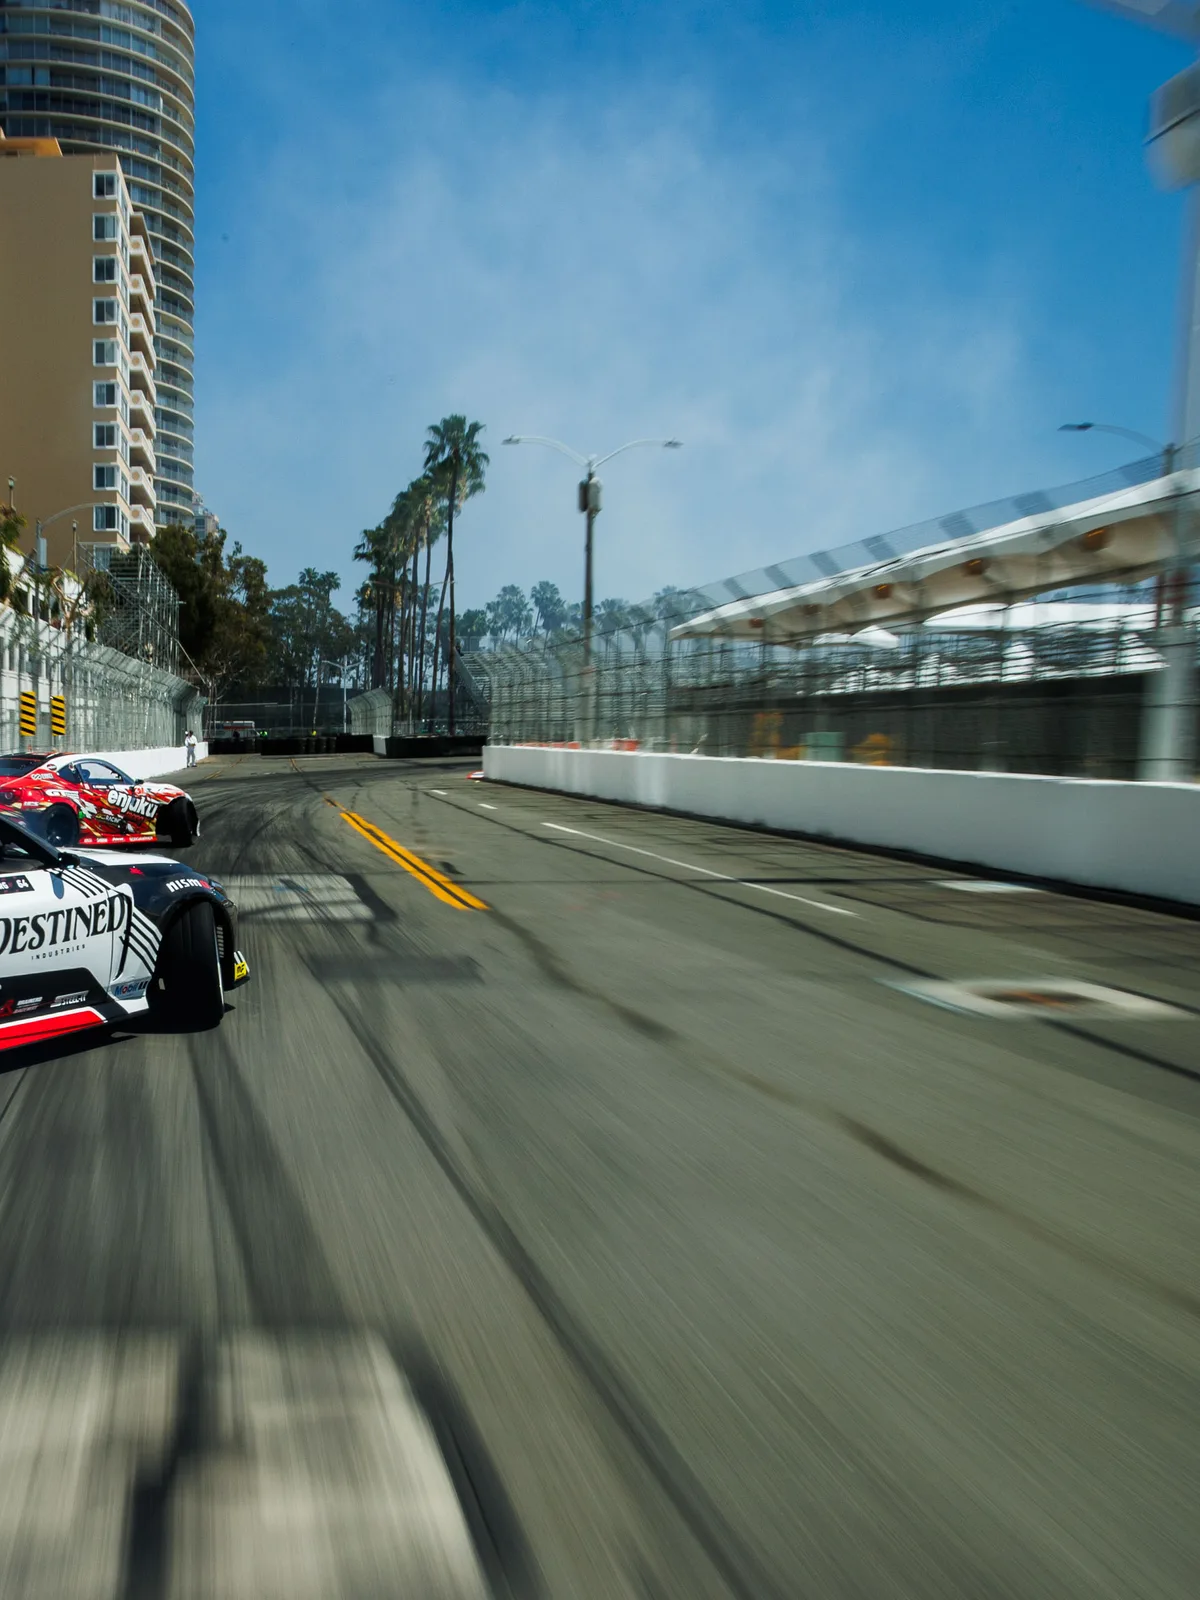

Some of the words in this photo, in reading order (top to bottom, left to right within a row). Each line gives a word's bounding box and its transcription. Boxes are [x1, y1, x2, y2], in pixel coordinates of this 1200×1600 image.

[107, 789, 158, 818] enjuku
[16, 879, 29, 889] 64
[31, 944, 86, 961] INDUSTRIES
